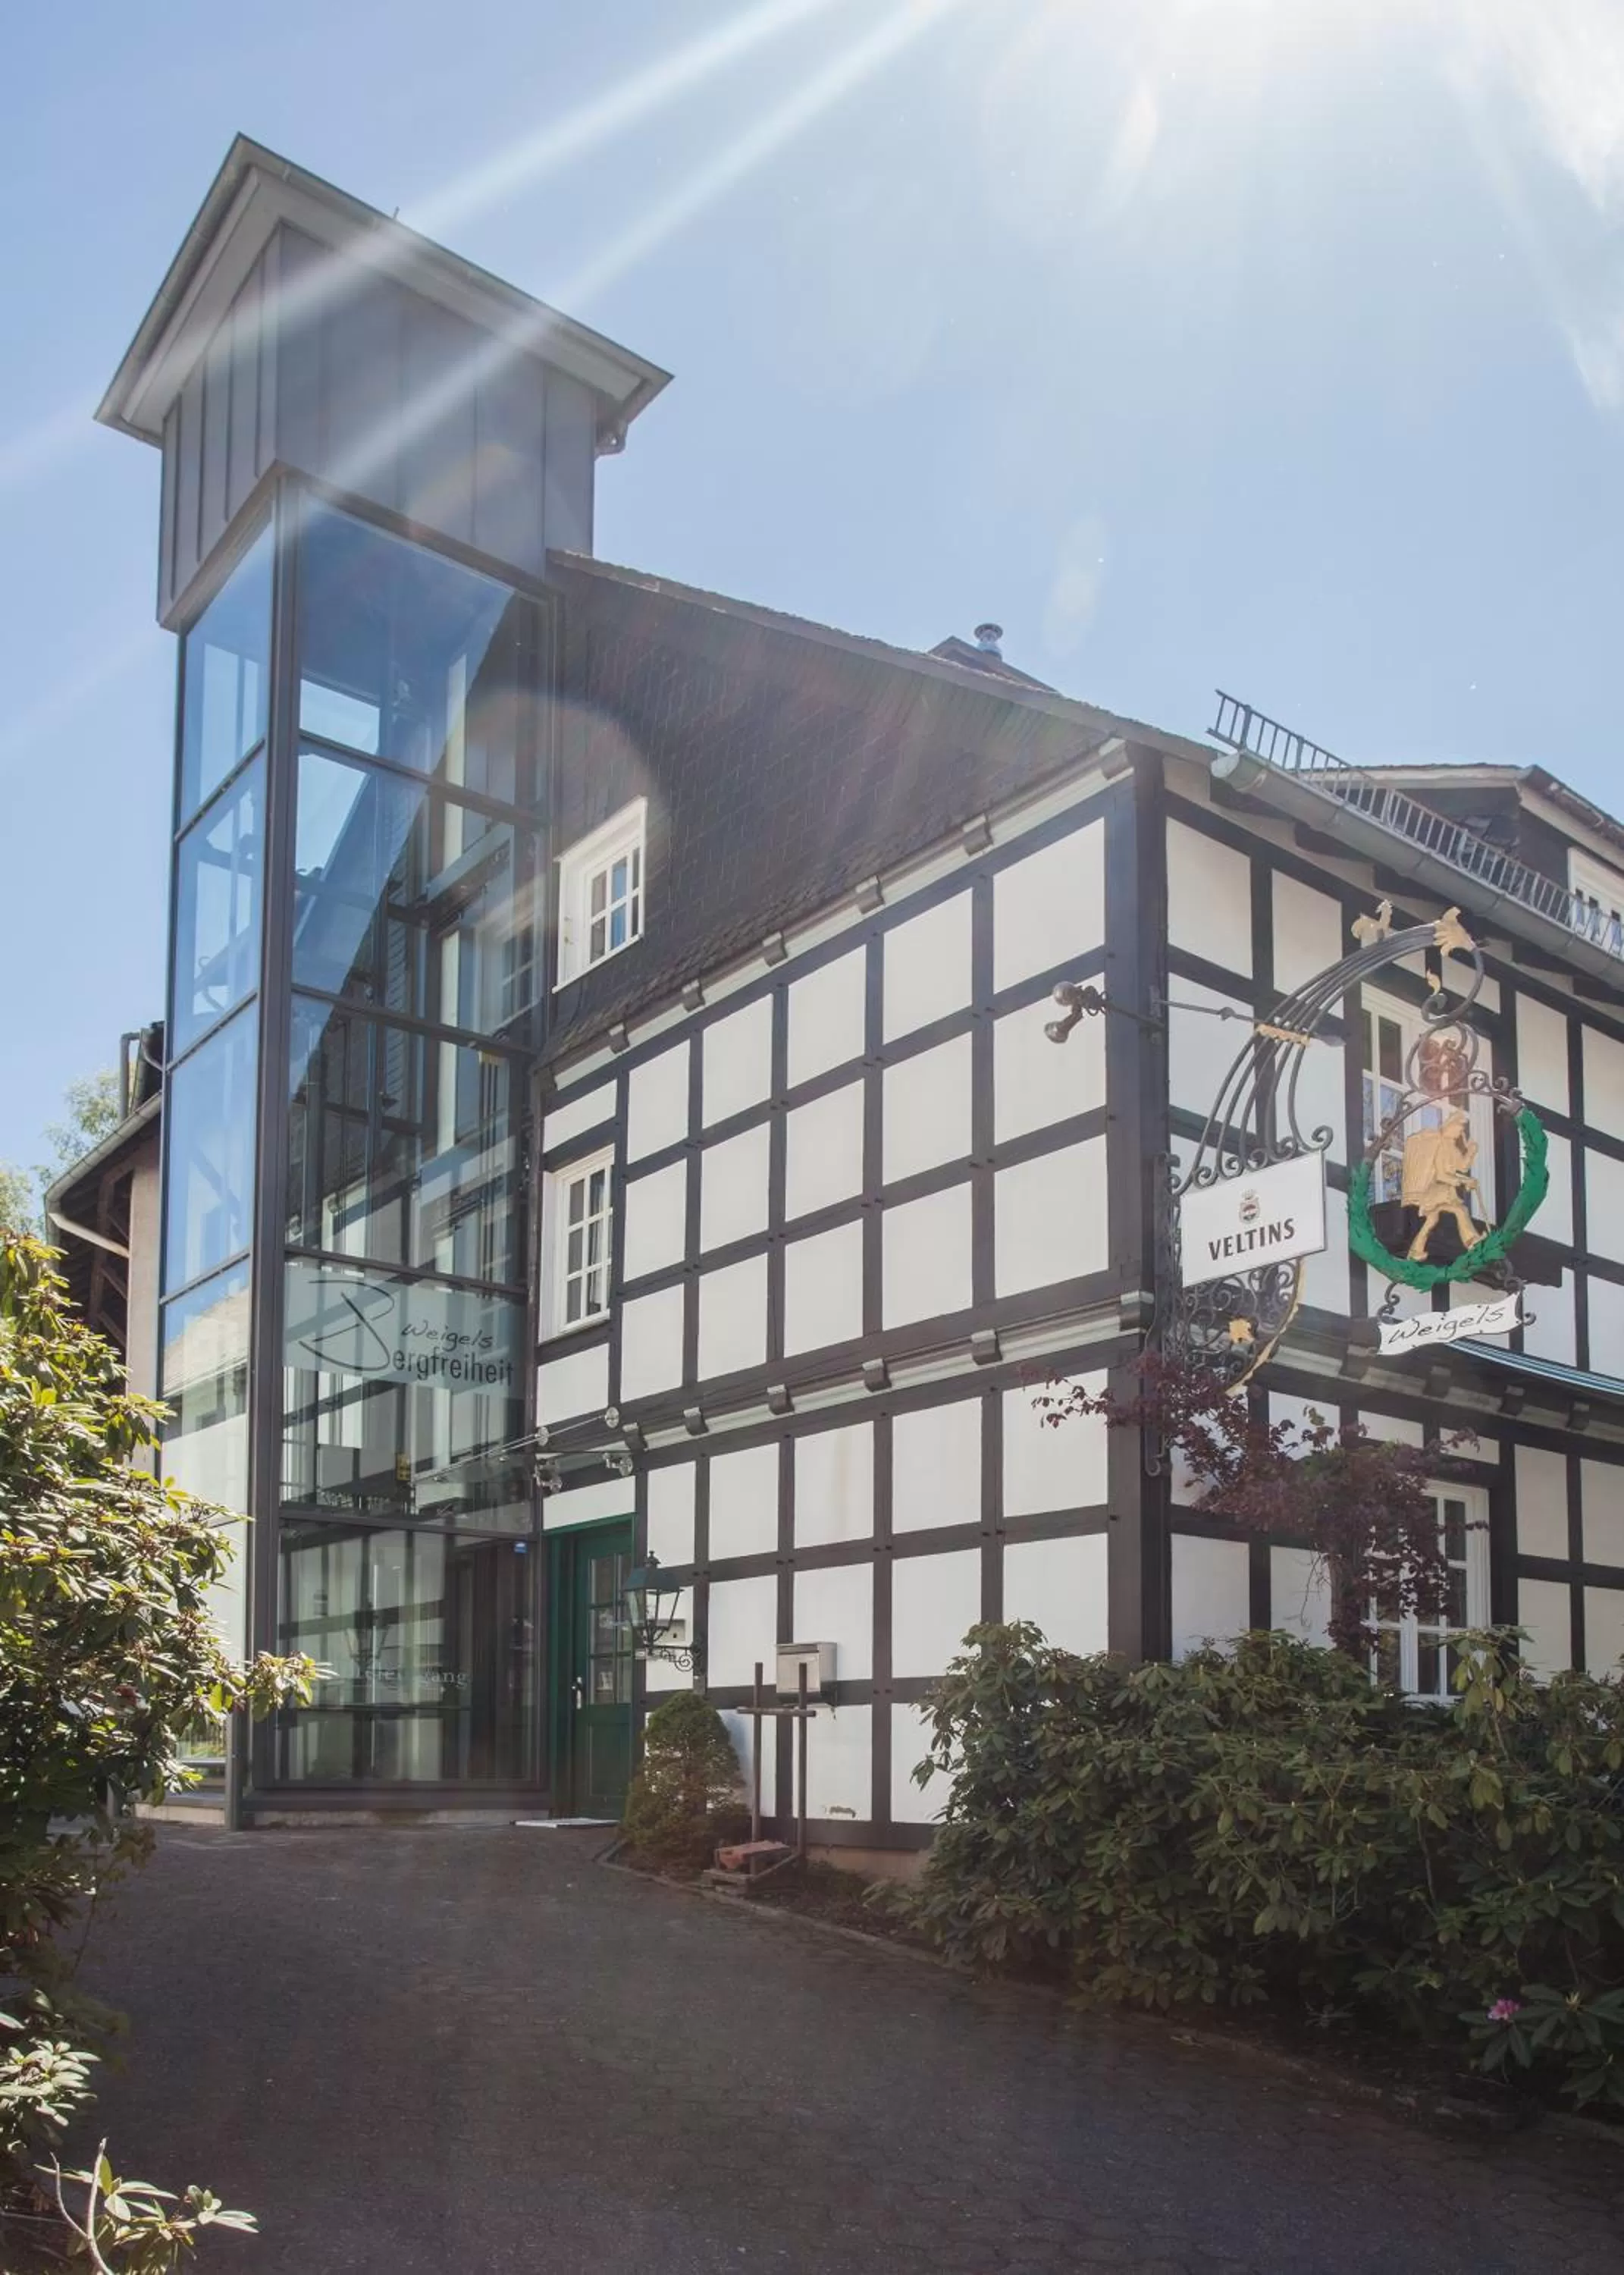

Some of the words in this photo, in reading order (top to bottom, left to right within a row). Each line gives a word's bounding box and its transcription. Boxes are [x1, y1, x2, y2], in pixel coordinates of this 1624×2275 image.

[1209, 1218, 1295, 1261] VELTINS
[401, 1320, 494, 1351] Weigels
[1387, 1304, 1506, 1345] Weigels
